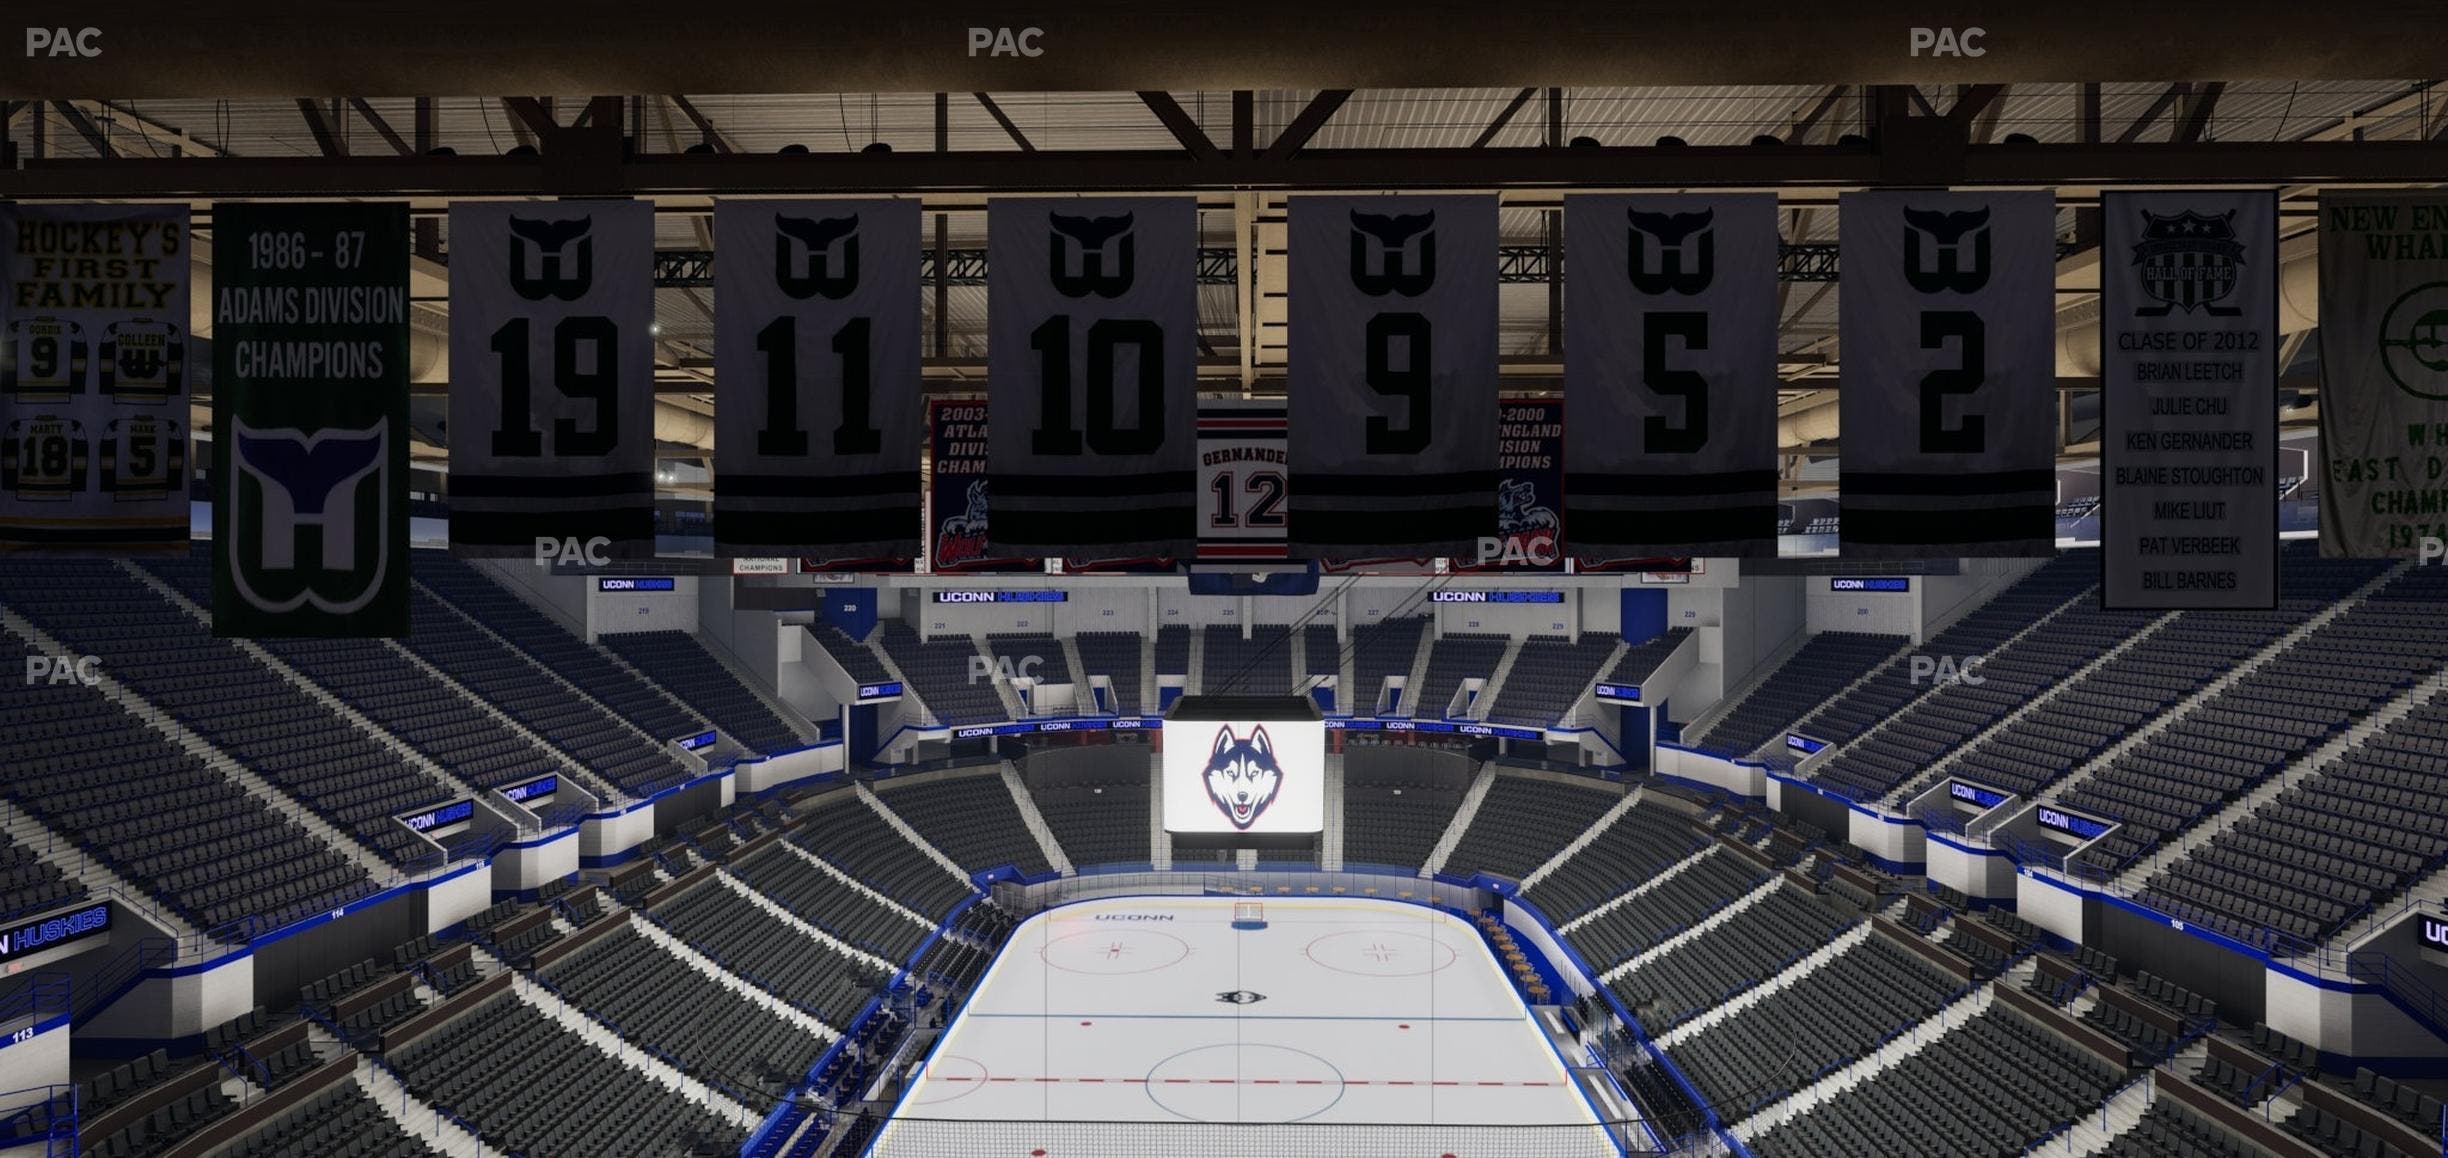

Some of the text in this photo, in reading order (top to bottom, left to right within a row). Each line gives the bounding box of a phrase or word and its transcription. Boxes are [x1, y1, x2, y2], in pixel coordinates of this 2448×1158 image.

[2330, 205, 2398, 232] NEW
[17, 220, 179, 254] HOCKEY'S
[335, 230, 367, 270] 87
[34, 257, 160, 279] FIRST
[16, 282, 175, 308] FAMILY
[218, 285, 404, 325] ADAMS DIVISION
[118, 333, 166, 347] COLLEEN
[2183, 332, 2207, 350] OF
[2214, 332, 2258, 351] 2012
[31, 336, 58, 378] 9
[235, 340, 384, 379] CHAMPIONS
[2137, 362, 2242, 381] BRIAN LEETCH
[491, 317, 618, 457] 19
[757, 316, 881, 456] 11
[1031, 315, 1165, 455] 10
[1366, 312, 1431, 455] 9
[1644, 311, 1708, 453] 5
[1920, 310, 1985, 453] 2
[2152, 398, 2226, 416] JULIE CHU
[943, 423, 988, 438] ATLA
[1500, 423, 1562, 438] NGLAND
[948, 441, 988, 456] DIVI
[2127, 432, 2253, 450] KEN GERNANDER
[23, 436, 68, 476] 18
[129, 436, 157, 477] 5
[1203, 447, 1288, 466] GERNANDE
[936, 459, 988, 474] CHAM
[2333, 456, 2400, 482] EAST
[2116, 467, 2263, 485] BLAINE STOUGHTON
[1211, 470, 1288, 528] 12
[2154, 502, 2226, 520] MIKE LIUT
[2140, 536, 2241, 554] PAT VERBEEK
[603, 580, 635, 589] UCONN
[1834, 580, 1864, 589] UCONN
[2143, 572, 2237, 590] BILL BARNES
[940, 592, 995, 602] UCONN
[1433, 592, 1486, 602] UCONN
[958, 727, 993, 738] UCONN
[1041, 722, 1071, 732] UCONN
[1112, 720, 1141, 729] UCONN
[1324, 721, 1346, 729] CONN
[1386, 722, 1415, 730] UCONN
[1460, 725, 1493, 735] UCONN
[1952, 783, 1976, 801] UCONN
[2039, 807, 2069, 830] UCONN
[13, 906, 108, 952] HUSKIES
[12, 1027, 34, 1044] 113
